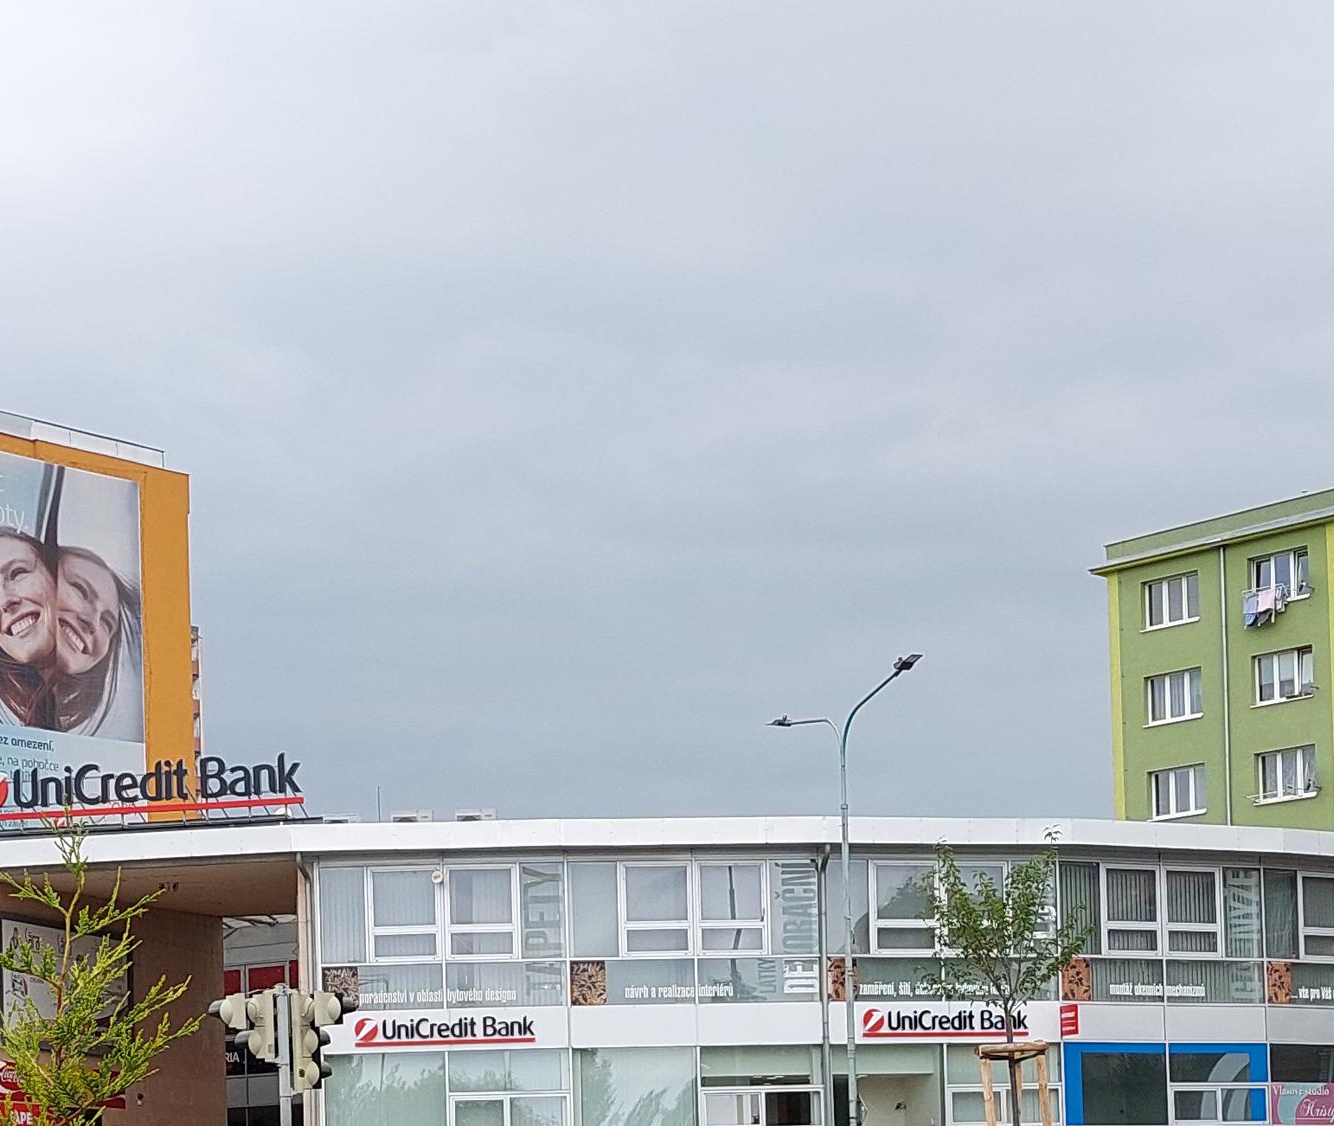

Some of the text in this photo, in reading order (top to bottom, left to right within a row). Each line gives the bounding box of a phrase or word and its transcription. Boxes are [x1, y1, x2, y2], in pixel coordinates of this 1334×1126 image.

[11, 737, 55, 752] omezení.
[7, 756, 19, 767] na
[21, 757, 59, 772] pobočce
[13, 751, 303, 808] UniCredit Bank
[358, 987, 517, 1005] poradenství v oblasti bytového designu
[624, 983, 648, 999] návrh
[650, 986, 656, 998] a
[859, 981, 897, 997] zaměření,
[382, 1015, 535, 1040] UniCredit Bank
[887, 1009, 975, 1031] UniCredit
